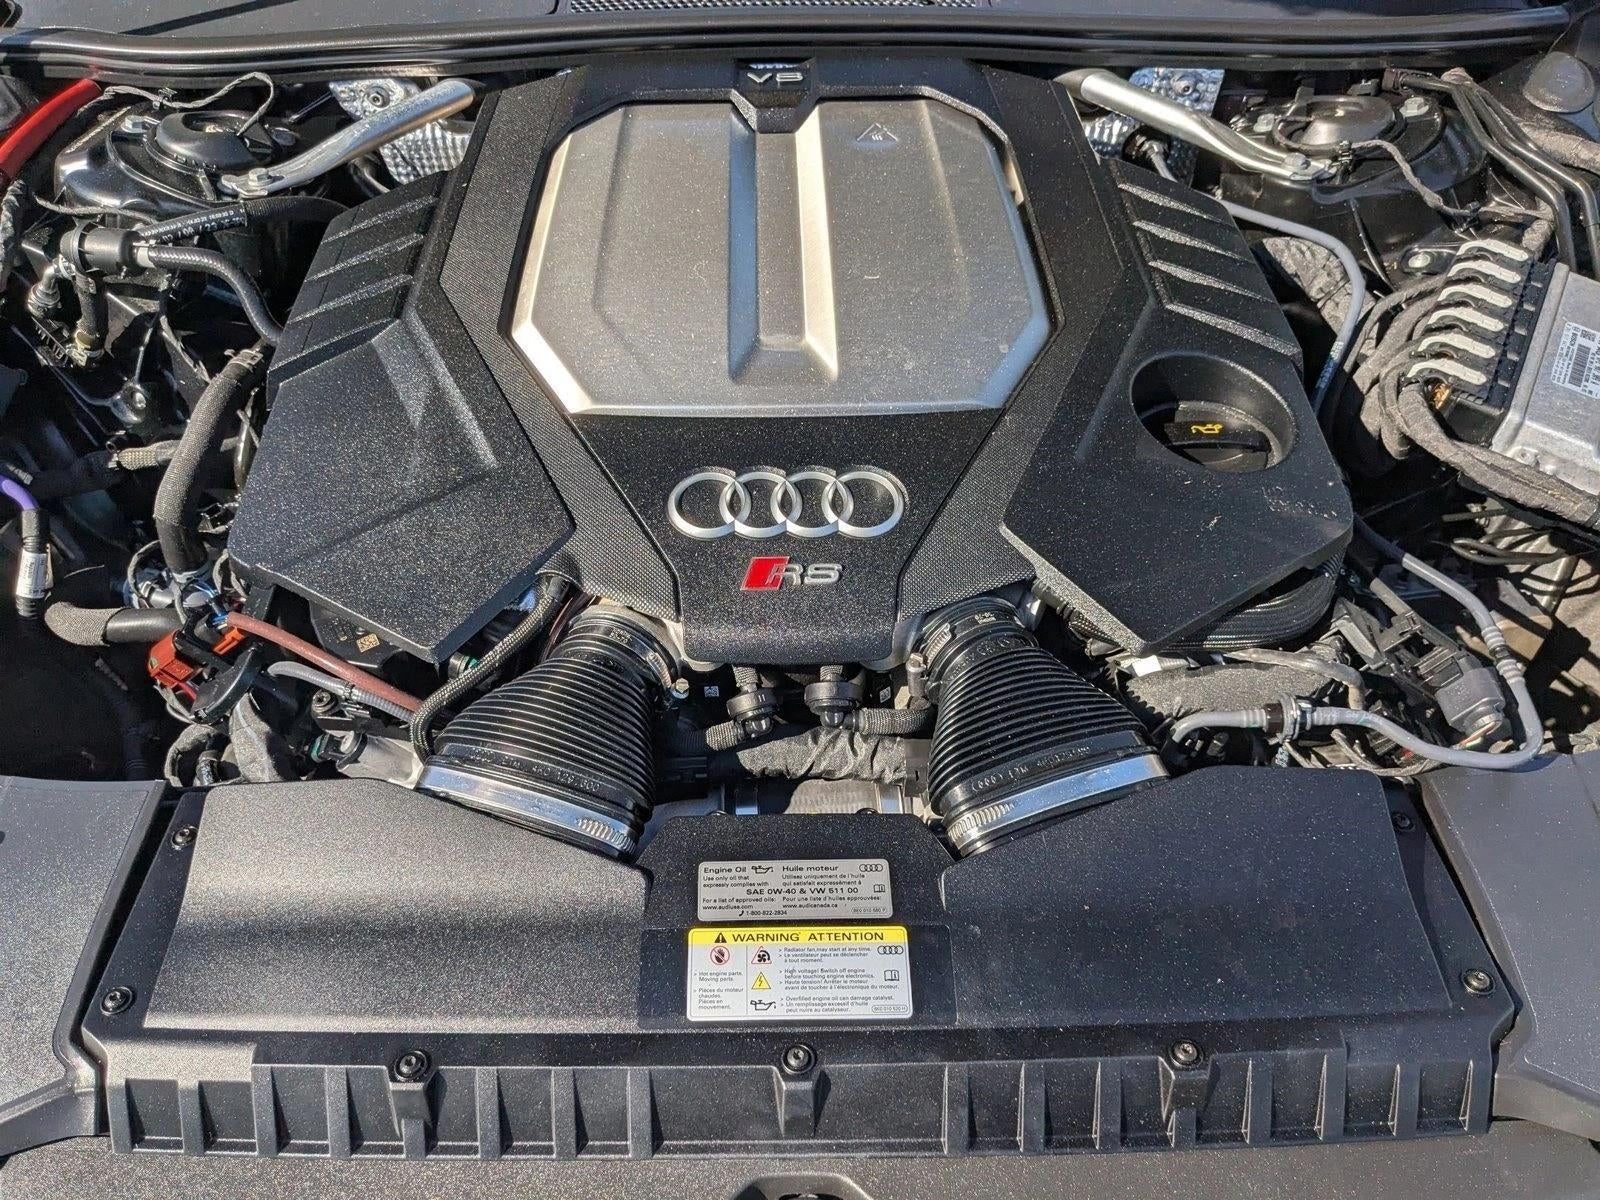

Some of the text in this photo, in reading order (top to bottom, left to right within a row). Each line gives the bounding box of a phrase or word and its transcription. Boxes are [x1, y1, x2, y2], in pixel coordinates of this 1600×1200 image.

[747, 72, 803, 83] V8
[762, 561, 843, 587] RS
[732, 932, 884, 942] WARNING ATTENTION
